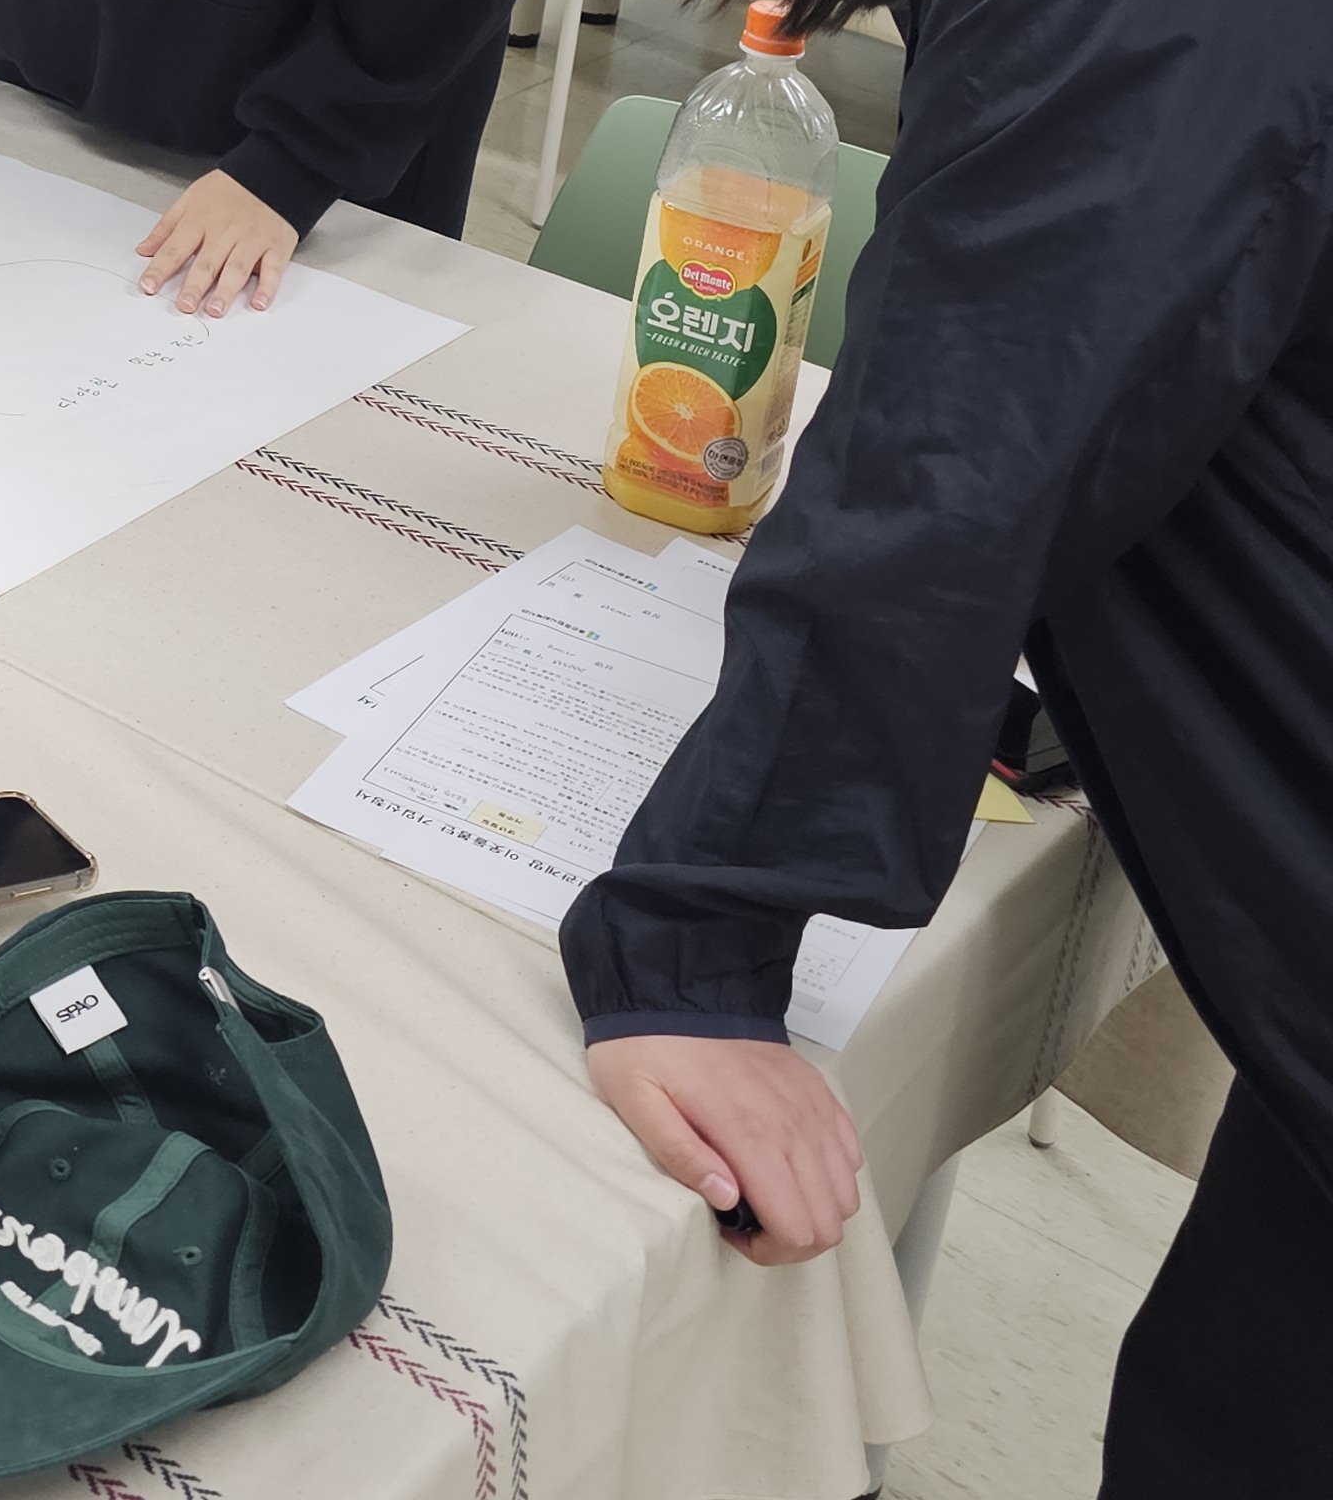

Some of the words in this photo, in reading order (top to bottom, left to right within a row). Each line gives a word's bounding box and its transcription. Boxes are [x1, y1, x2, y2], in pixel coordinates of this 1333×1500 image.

[683, 236, 745, 260] ORANGE
[683, 266, 700, 281] Del
[700, 272, 732, 291] Monte
[647, 294, 755, 353] 오렌지
[688, 344, 710, 357] RICH
[58, 376, 118, 410] 다양한
[129, 351, 175, 367] 만남
[354, 788, 433, 827] 가입신청서
[439, 823, 520, 864] 이웃돌봄단
[55, 993, 99, 1025] SPAO
